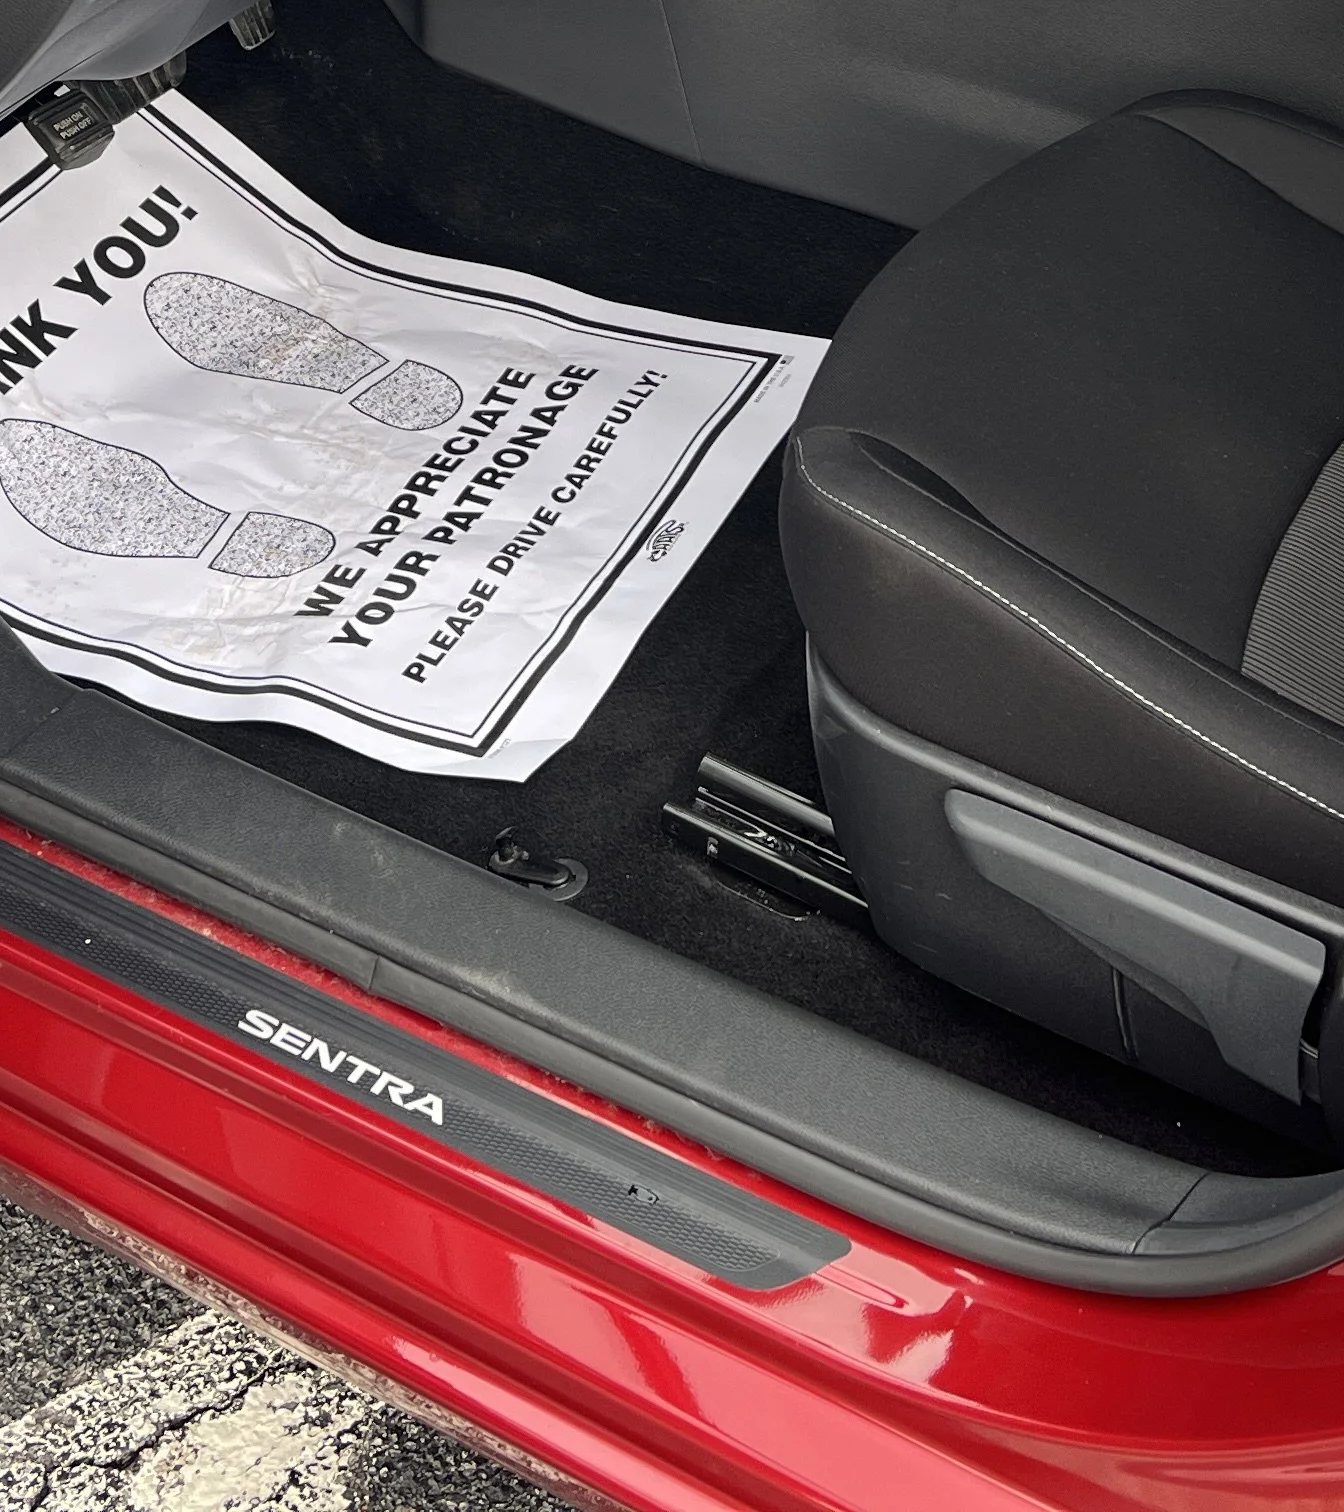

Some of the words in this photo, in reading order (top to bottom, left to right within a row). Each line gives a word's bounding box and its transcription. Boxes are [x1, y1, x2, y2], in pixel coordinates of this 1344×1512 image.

[53, 184, 200, 307] YOU!
[293, 563, 367, 618] WE
[354, 366, 538, 558] APPRECIATE
[327, 550, 442, 649] YOUR
[421, 363, 601, 547] PATRONAGE
[401, 578, 500, 685] PLEASE
[485, 504, 561, 577] DRIVE
[550, 368, 670, 505] CAREFULLY!
[237, 1008, 444, 1126] SENTRA
